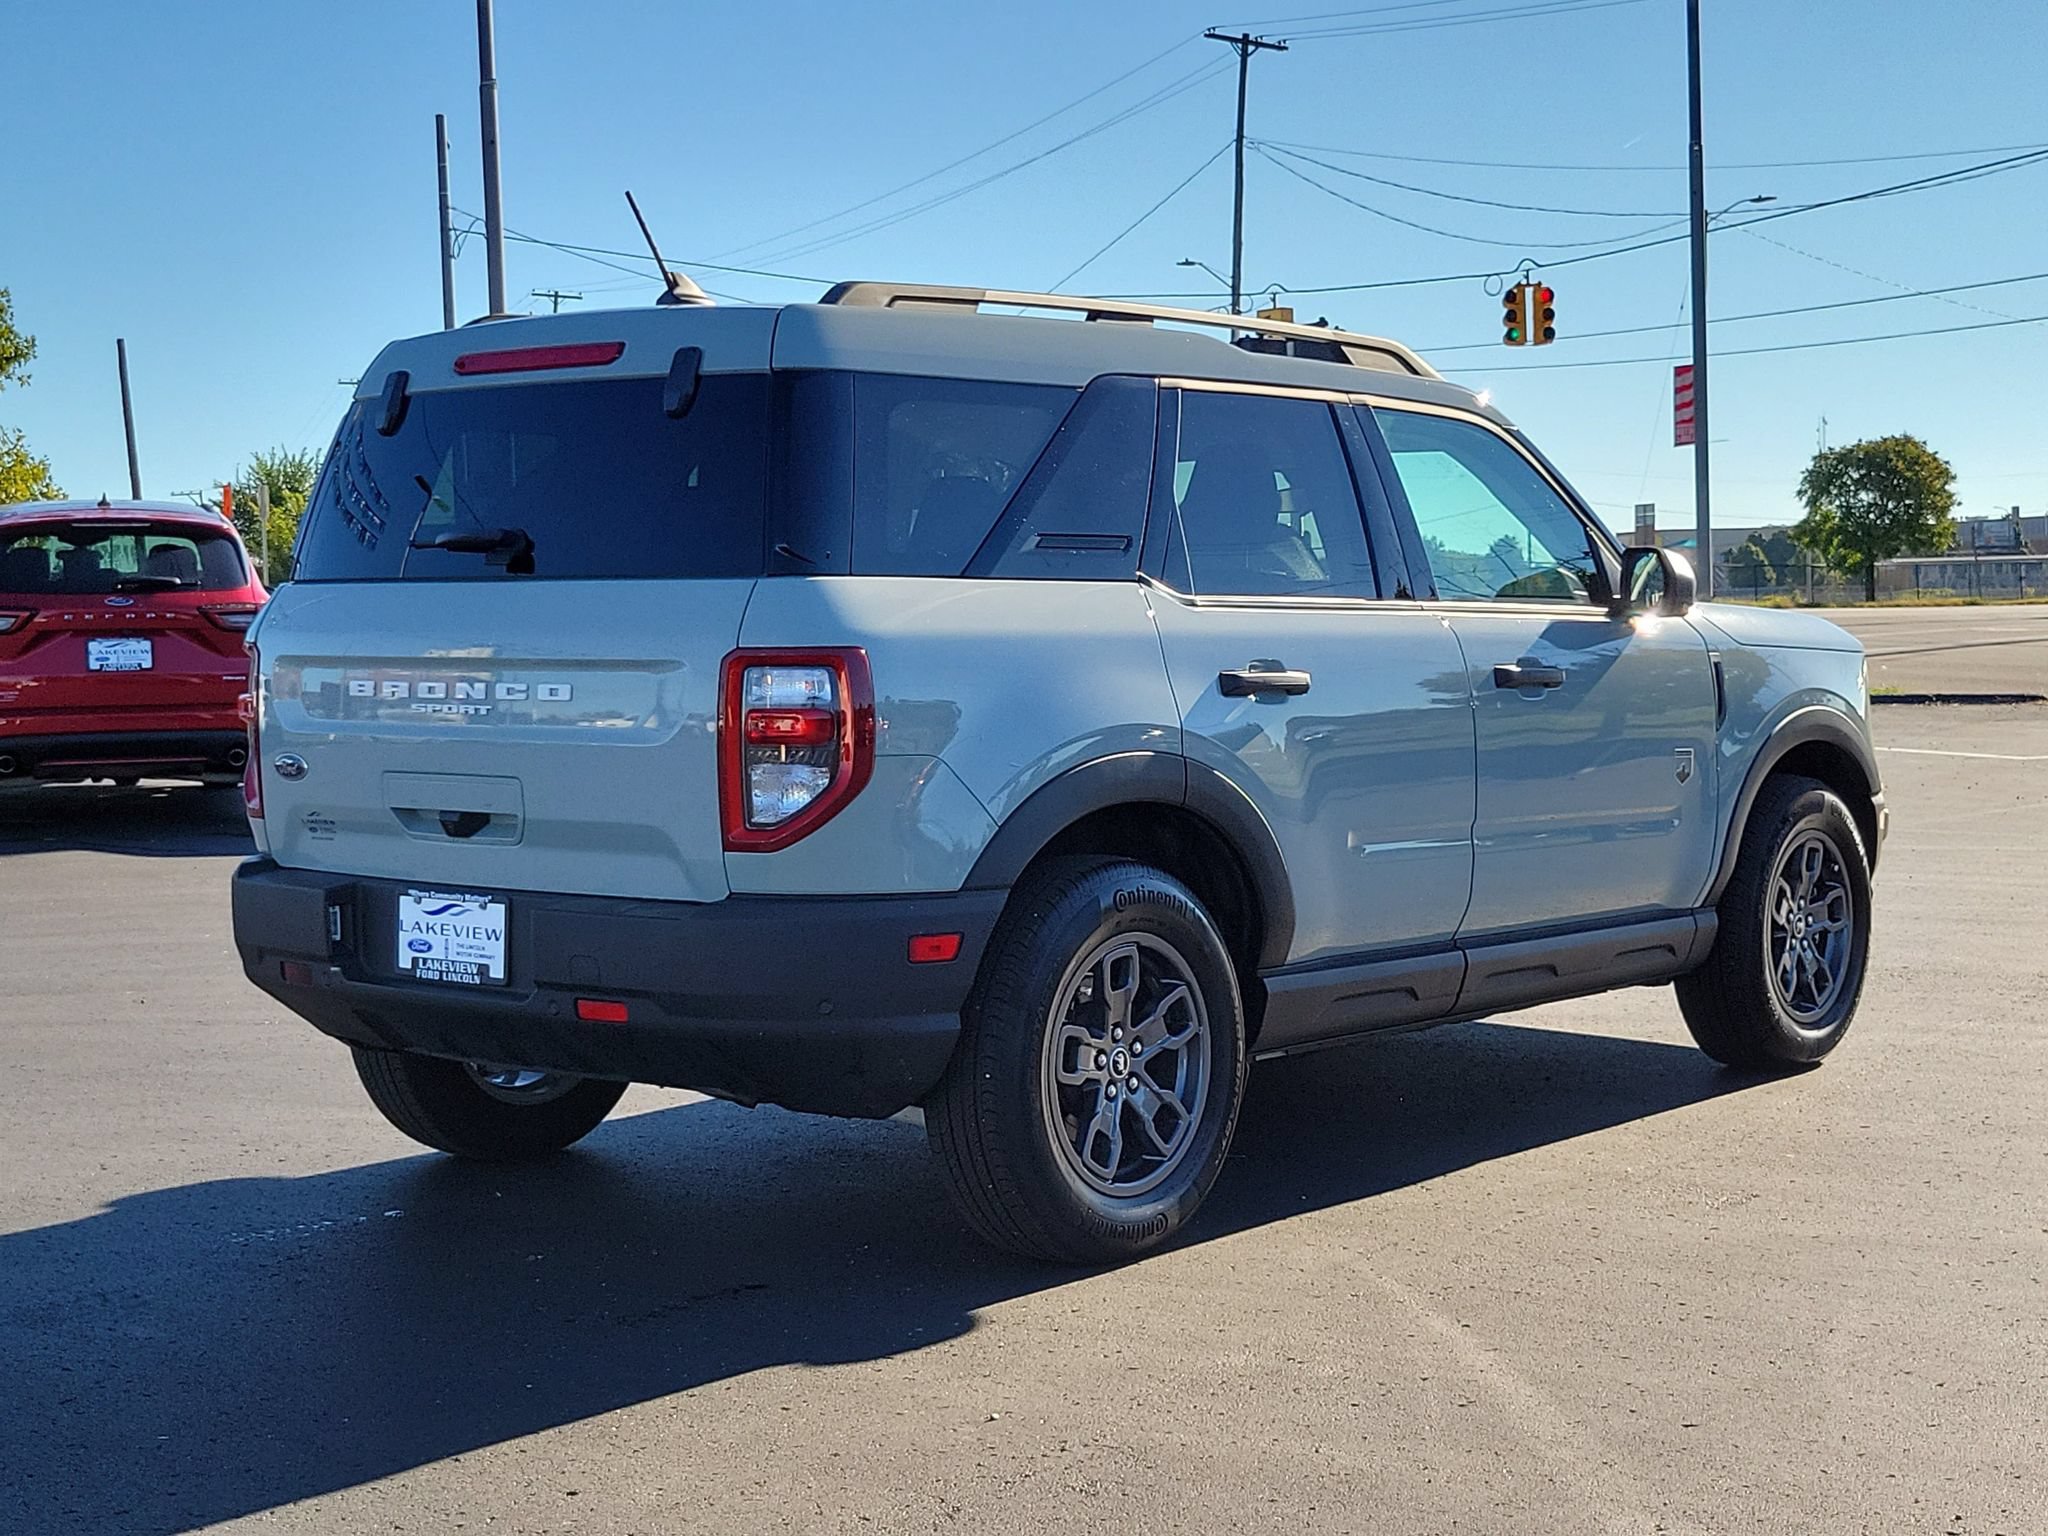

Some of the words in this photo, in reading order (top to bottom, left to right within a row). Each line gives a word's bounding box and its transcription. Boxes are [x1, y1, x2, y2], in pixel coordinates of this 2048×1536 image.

[349, 680, 573, 701] BRONCO
[411, 703, 493, 715] SPORT
[1113, 884, 1188, 918] Continental
[400, 919, 503, 942] LAKEVIEW
[418, 958, 479, 974] LAKEVIEW
[416, 969, 440, 981] FORD
[442, 971, 481, 985] LINCOLN
